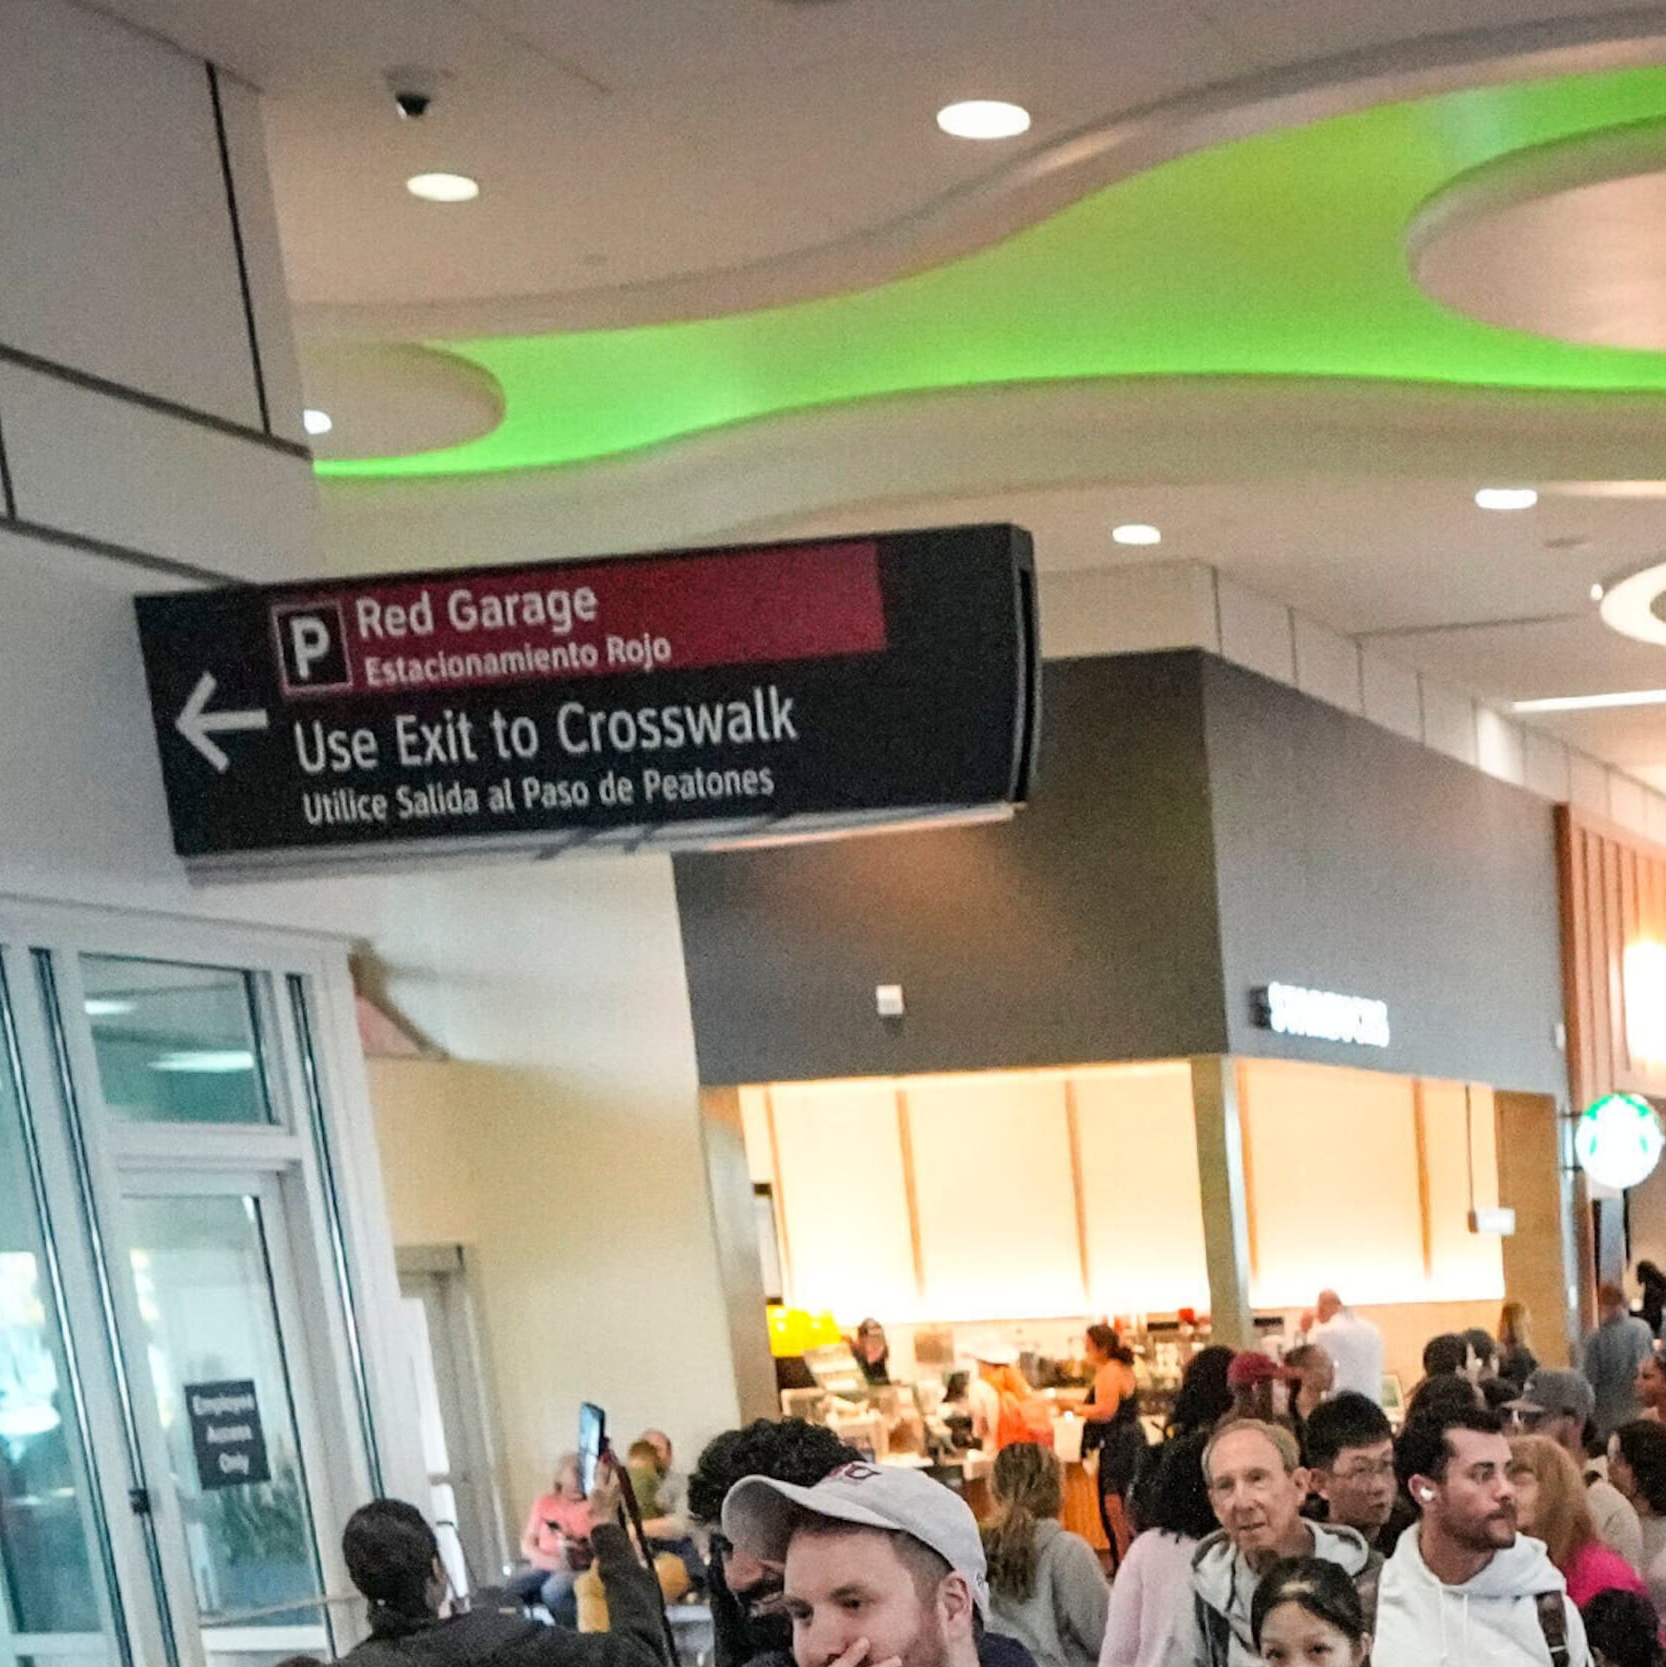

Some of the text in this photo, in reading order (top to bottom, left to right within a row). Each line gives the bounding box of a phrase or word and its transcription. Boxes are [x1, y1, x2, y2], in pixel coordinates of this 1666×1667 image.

[356, 585, 599, 639] Red Garage
[289, 614, 331, 679] P
[364, 631, 672, 686] Estacionamiento Rojo
[294, 684, 799, 774] Use Exit to Crosswalk
[302, 765, 775, 826] Utilice Salida al Paso de Peatones
